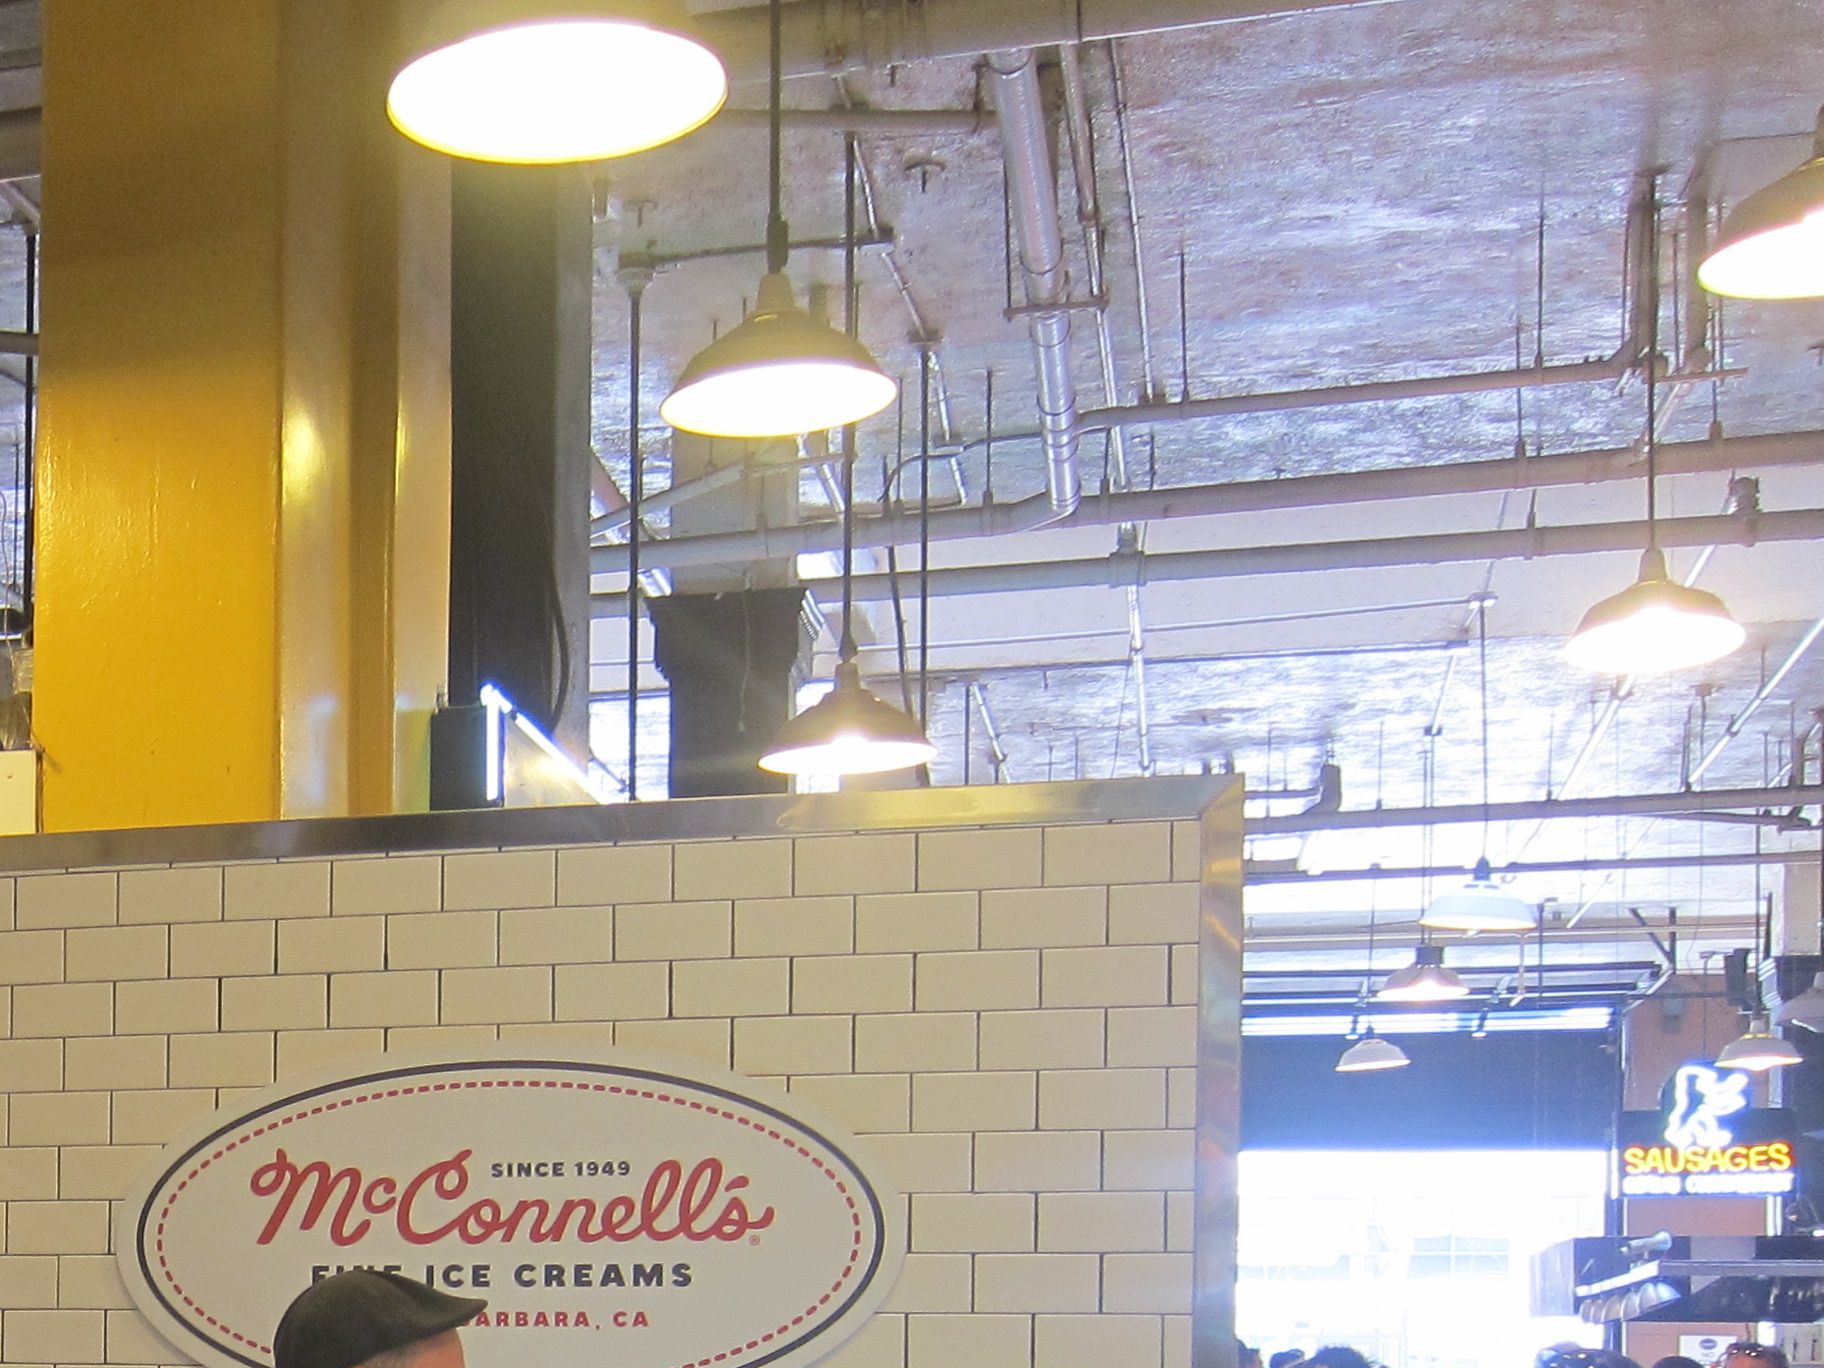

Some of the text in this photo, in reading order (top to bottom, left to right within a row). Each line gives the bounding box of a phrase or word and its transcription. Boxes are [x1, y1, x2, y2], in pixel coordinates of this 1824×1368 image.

[491, 1160, 631, 1178] SINCE 1949
[1622, 1142, 1793, 1176] SAUSAGES
[249, 1148, 775, 1247] McConnell's
[425, 1264, 492, 1288] ICE
[513, 1263, 692, 1288] CREAMS
[613, 1311, 649, 1327] CA
